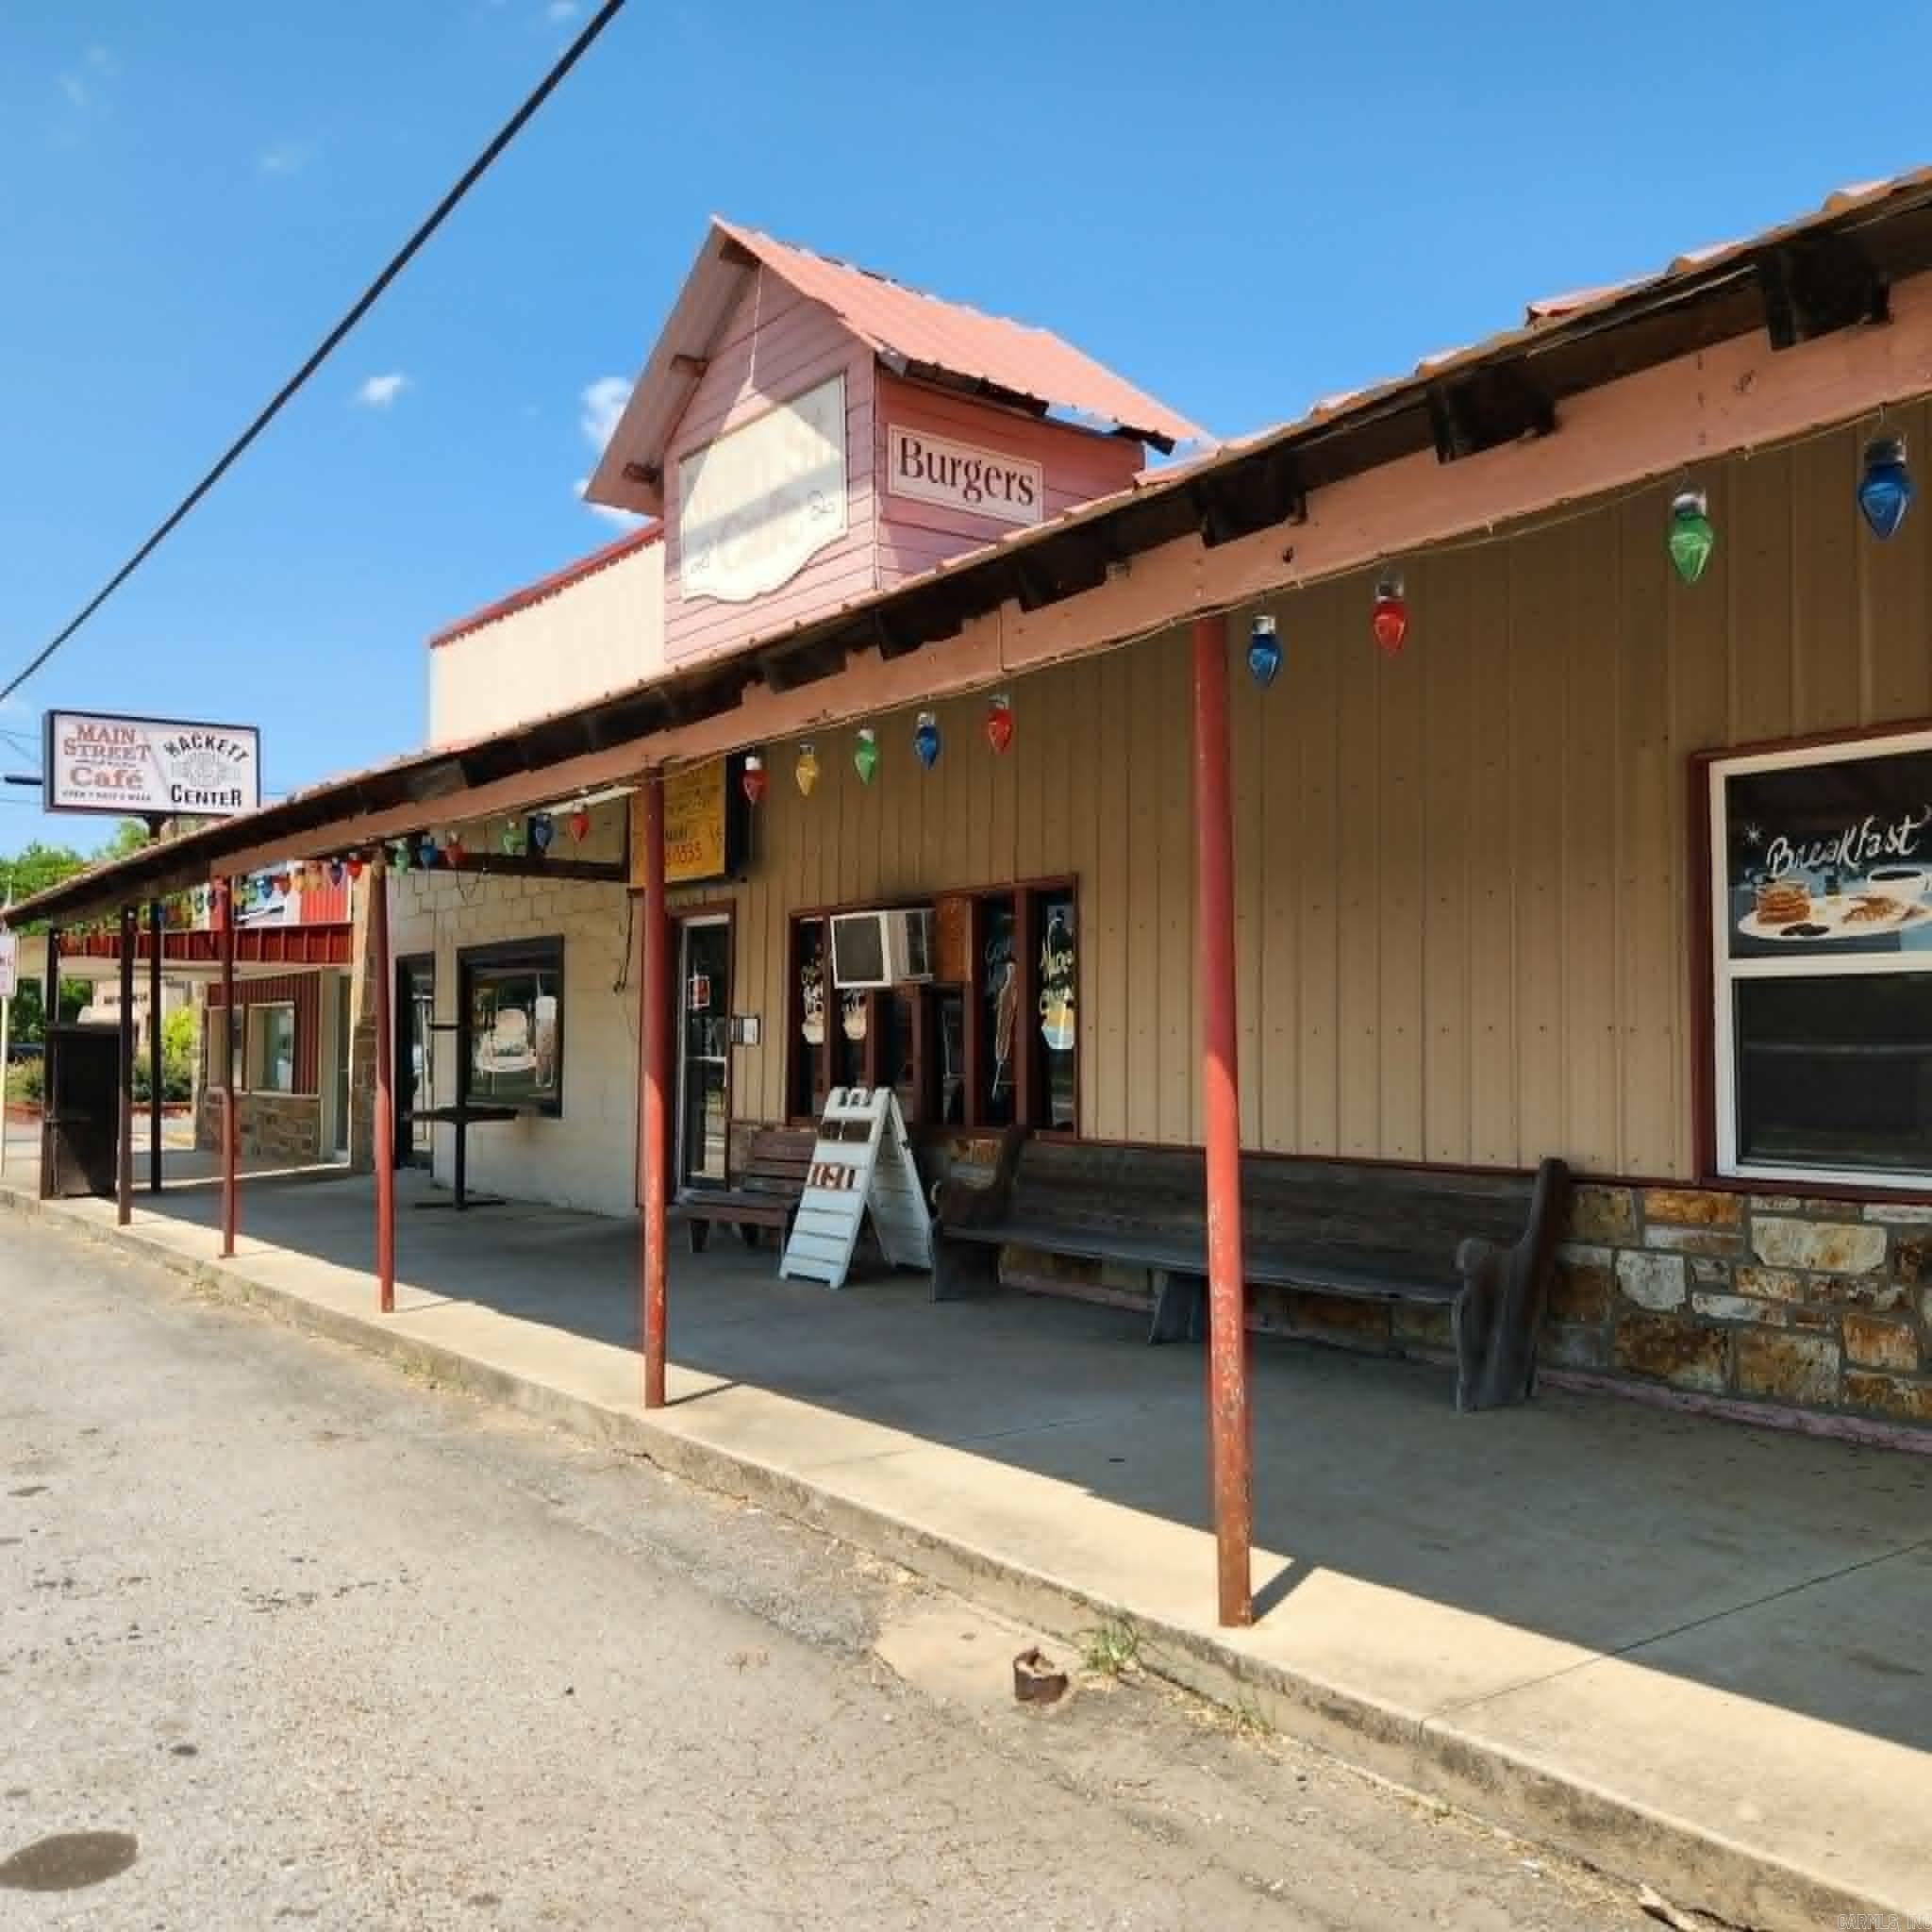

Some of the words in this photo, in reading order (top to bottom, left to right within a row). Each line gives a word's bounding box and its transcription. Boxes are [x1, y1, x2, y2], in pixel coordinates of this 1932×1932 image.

[898, 436, 1036, 507] Burgers
[75, 724, 137, 745] MAIN
[163, 732, 250, 763] HACKETT
[63, 736, 152, 762] STREET
[171, 784, 242, 808] CENTER
[1765, 813, 1921, 877] Breakfast
